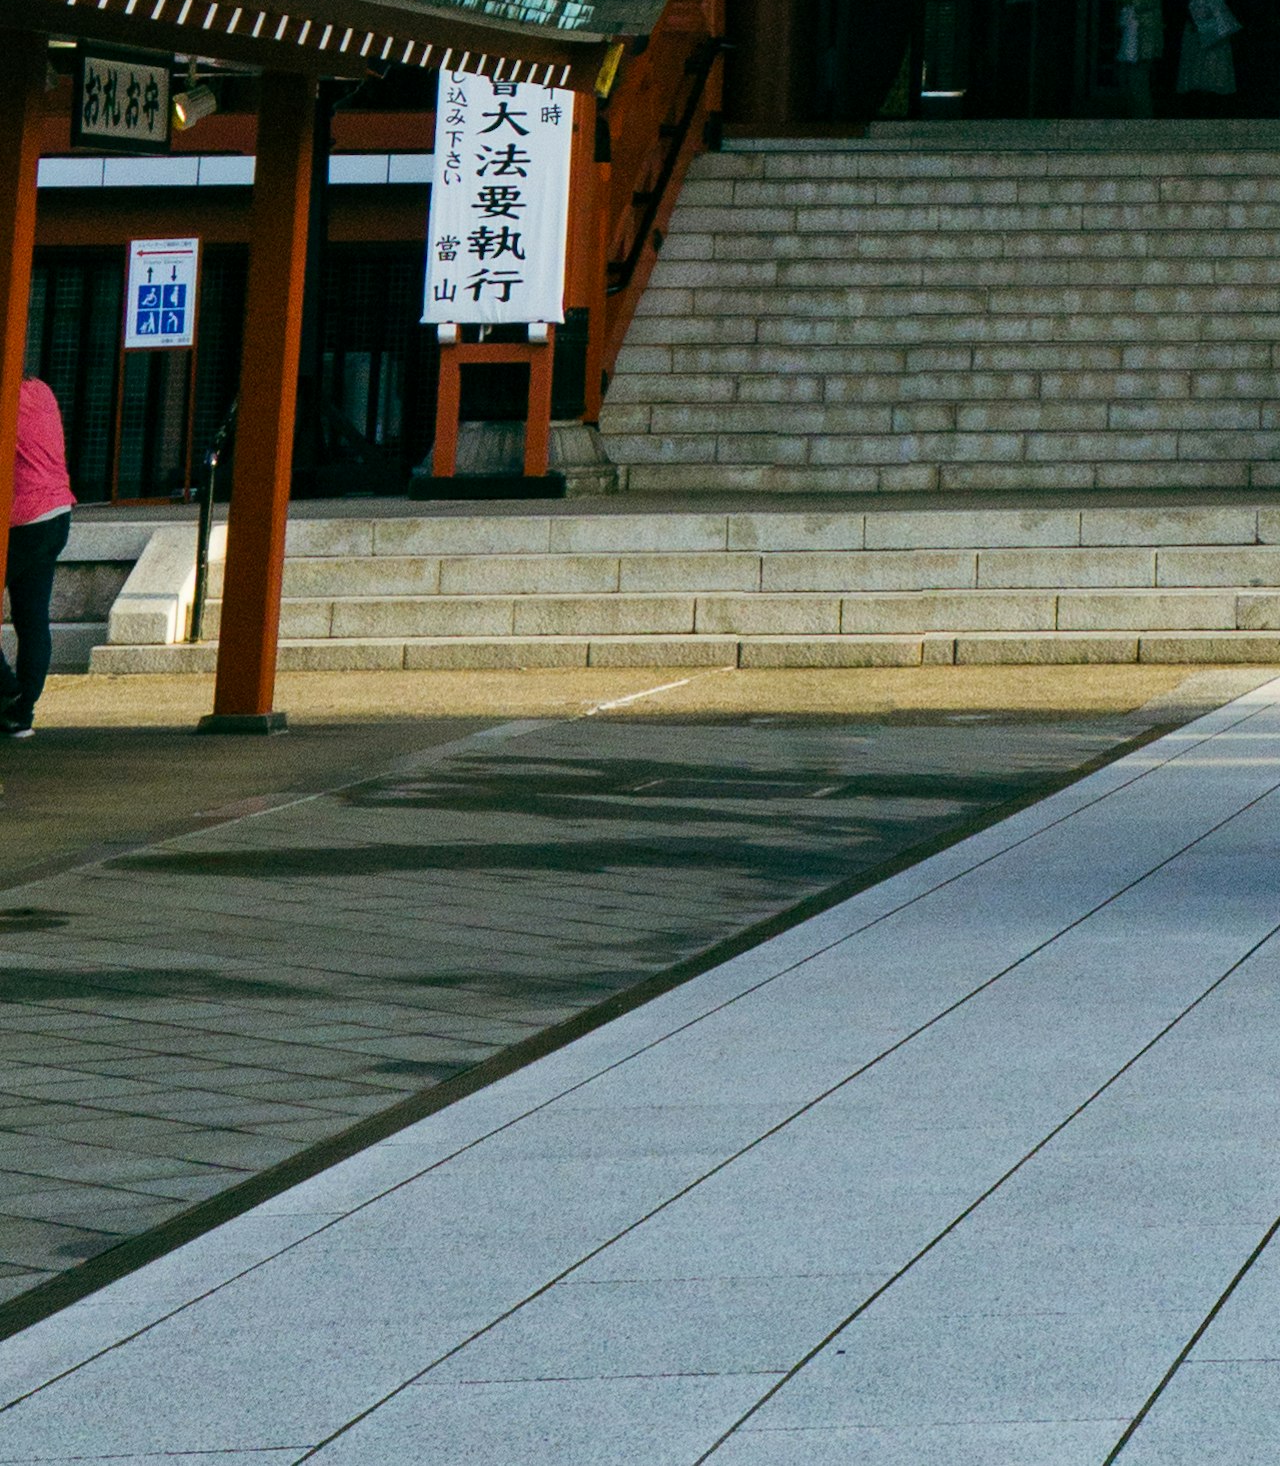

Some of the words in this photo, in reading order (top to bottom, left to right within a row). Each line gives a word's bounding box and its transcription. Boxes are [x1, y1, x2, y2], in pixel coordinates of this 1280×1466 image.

[84, 66, 159, 133] お札お守
[433, 234, 461, 303] 當山
